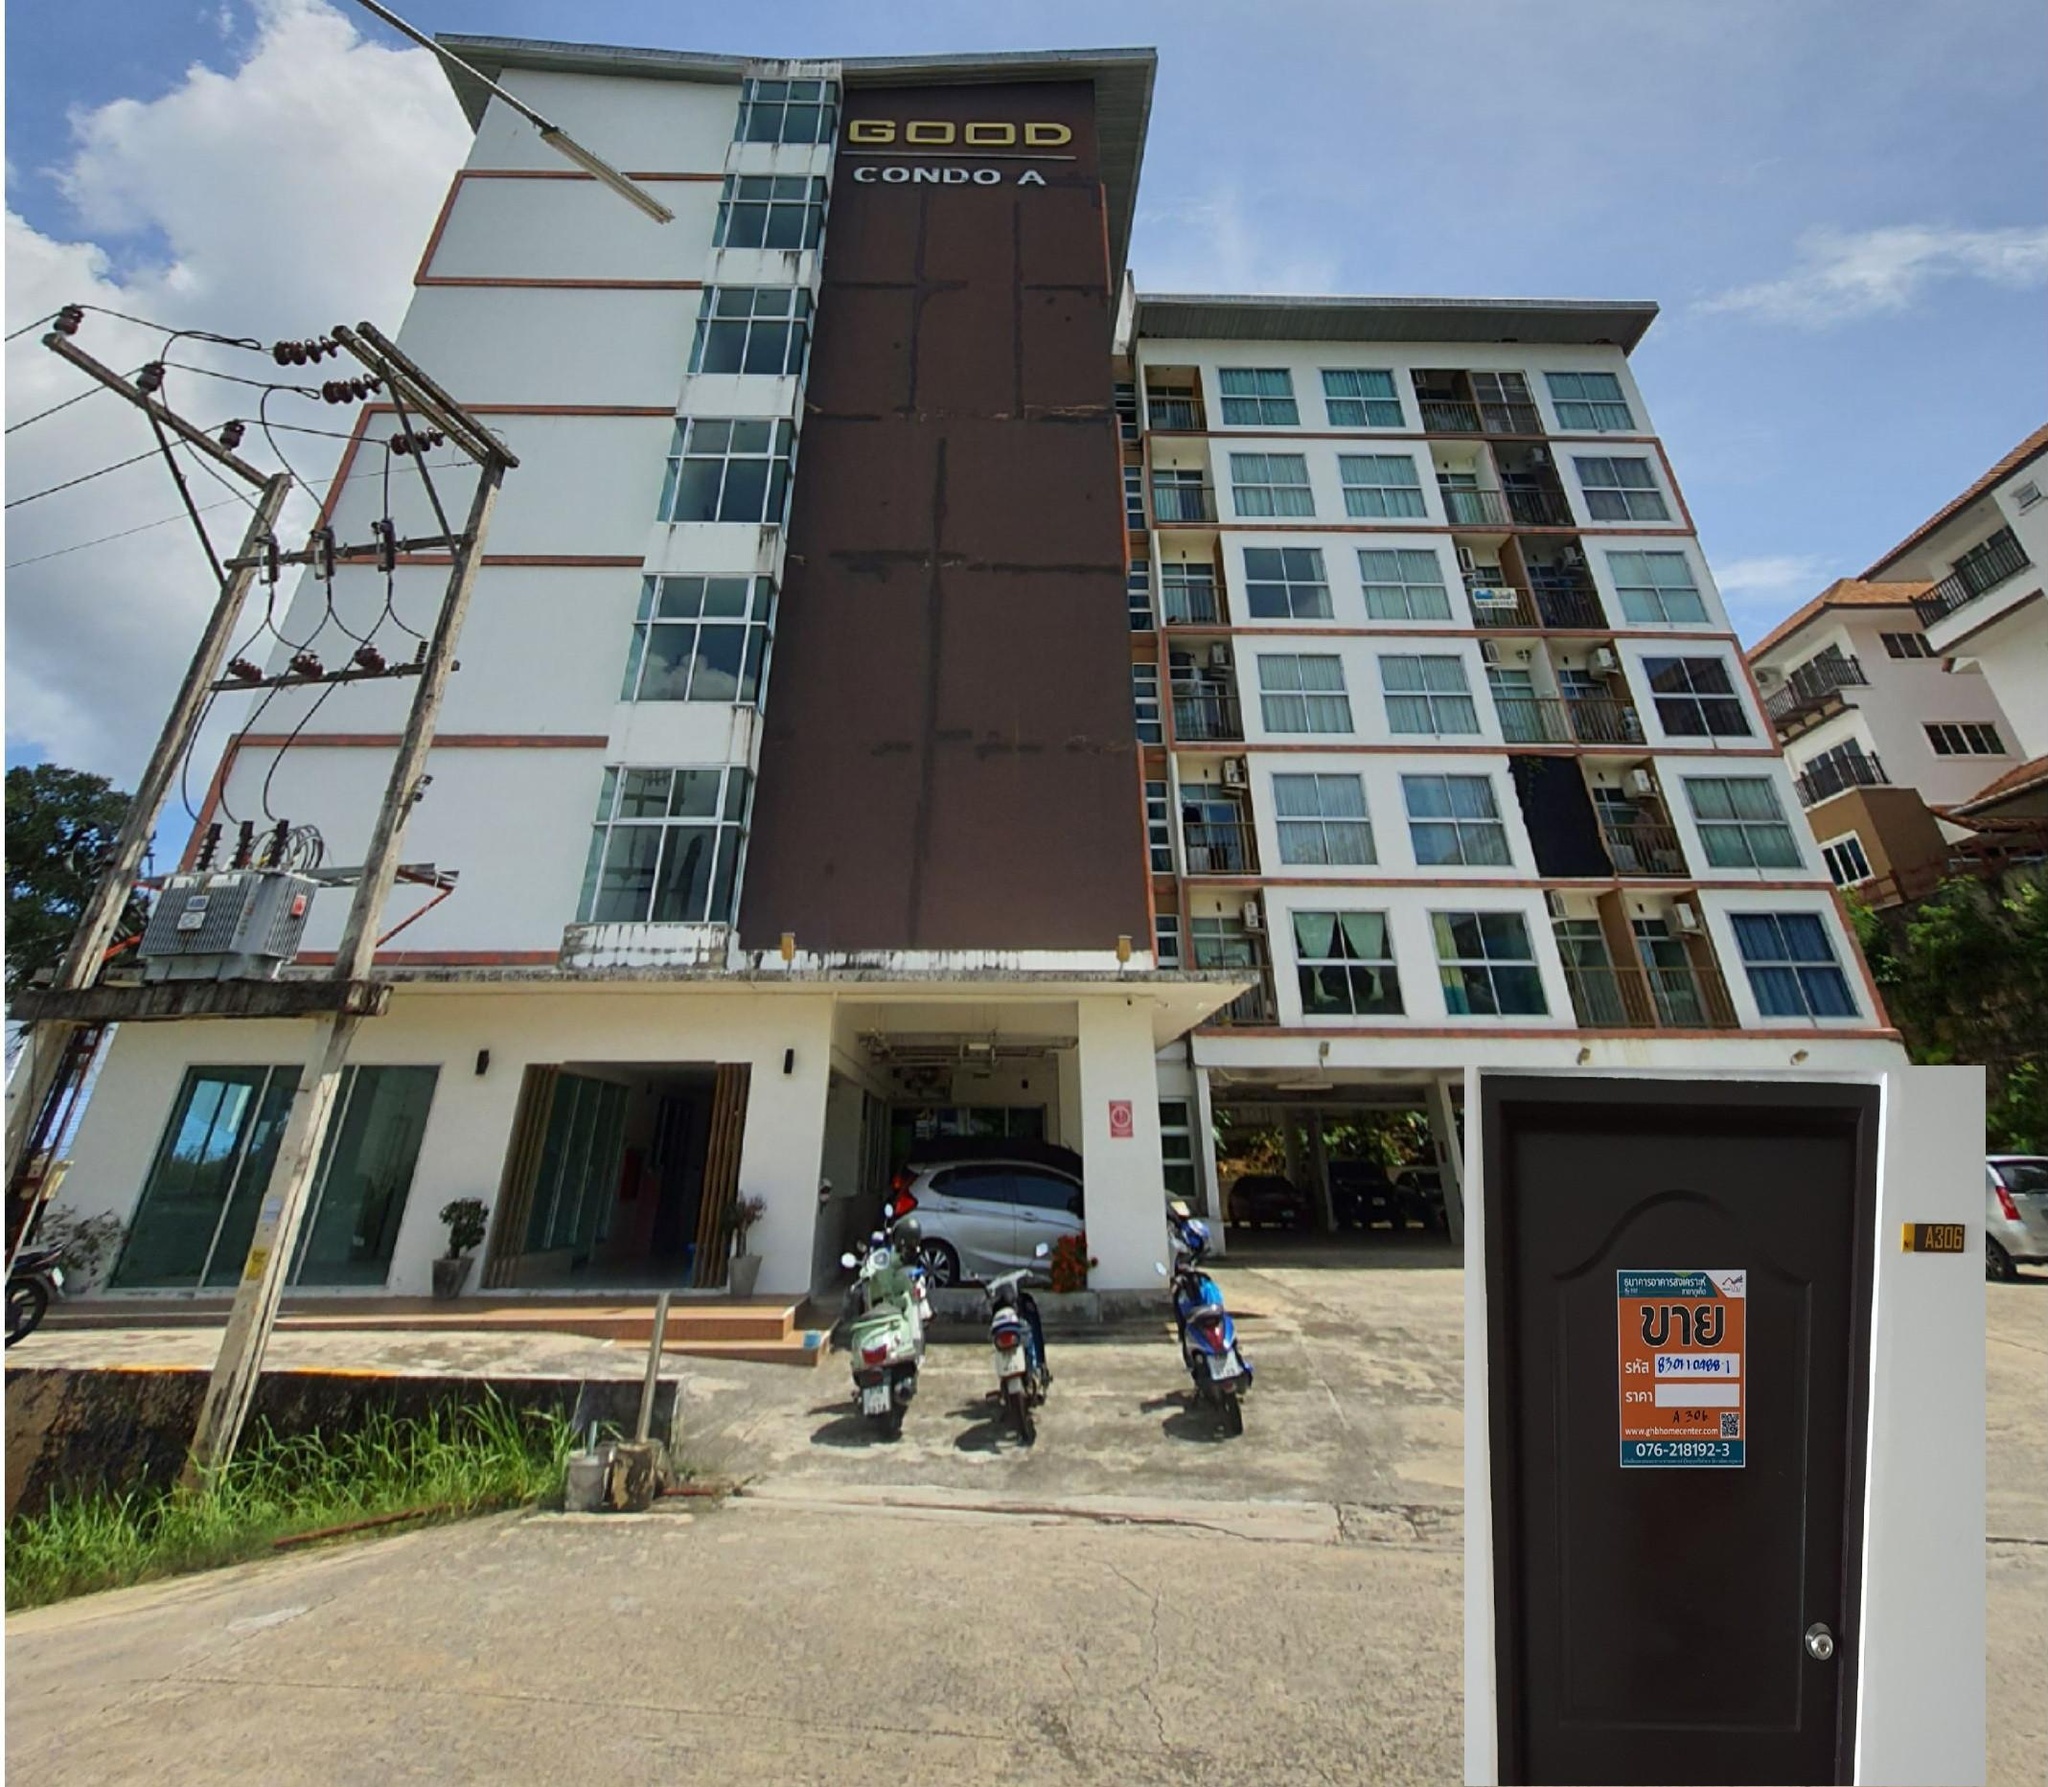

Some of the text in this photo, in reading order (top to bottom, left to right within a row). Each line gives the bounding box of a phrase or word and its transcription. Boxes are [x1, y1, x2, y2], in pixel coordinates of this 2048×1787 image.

[848, 119, 1073, 146] GOOD
[853, 166, 1047, 186] CONDO A
[1924, 1225, 1964, 1250] A306
[1640, 1304, 1726, 1348] ขาย
[1624, 1357, 1650, 1374] รหัส
[1625, 1391, 1653, 1403] ราคา
[1624, 1426, 1719, 1437] www.ghbhomecenter.com
[1635, 1442, 1730, 1457] 076-218192-3
